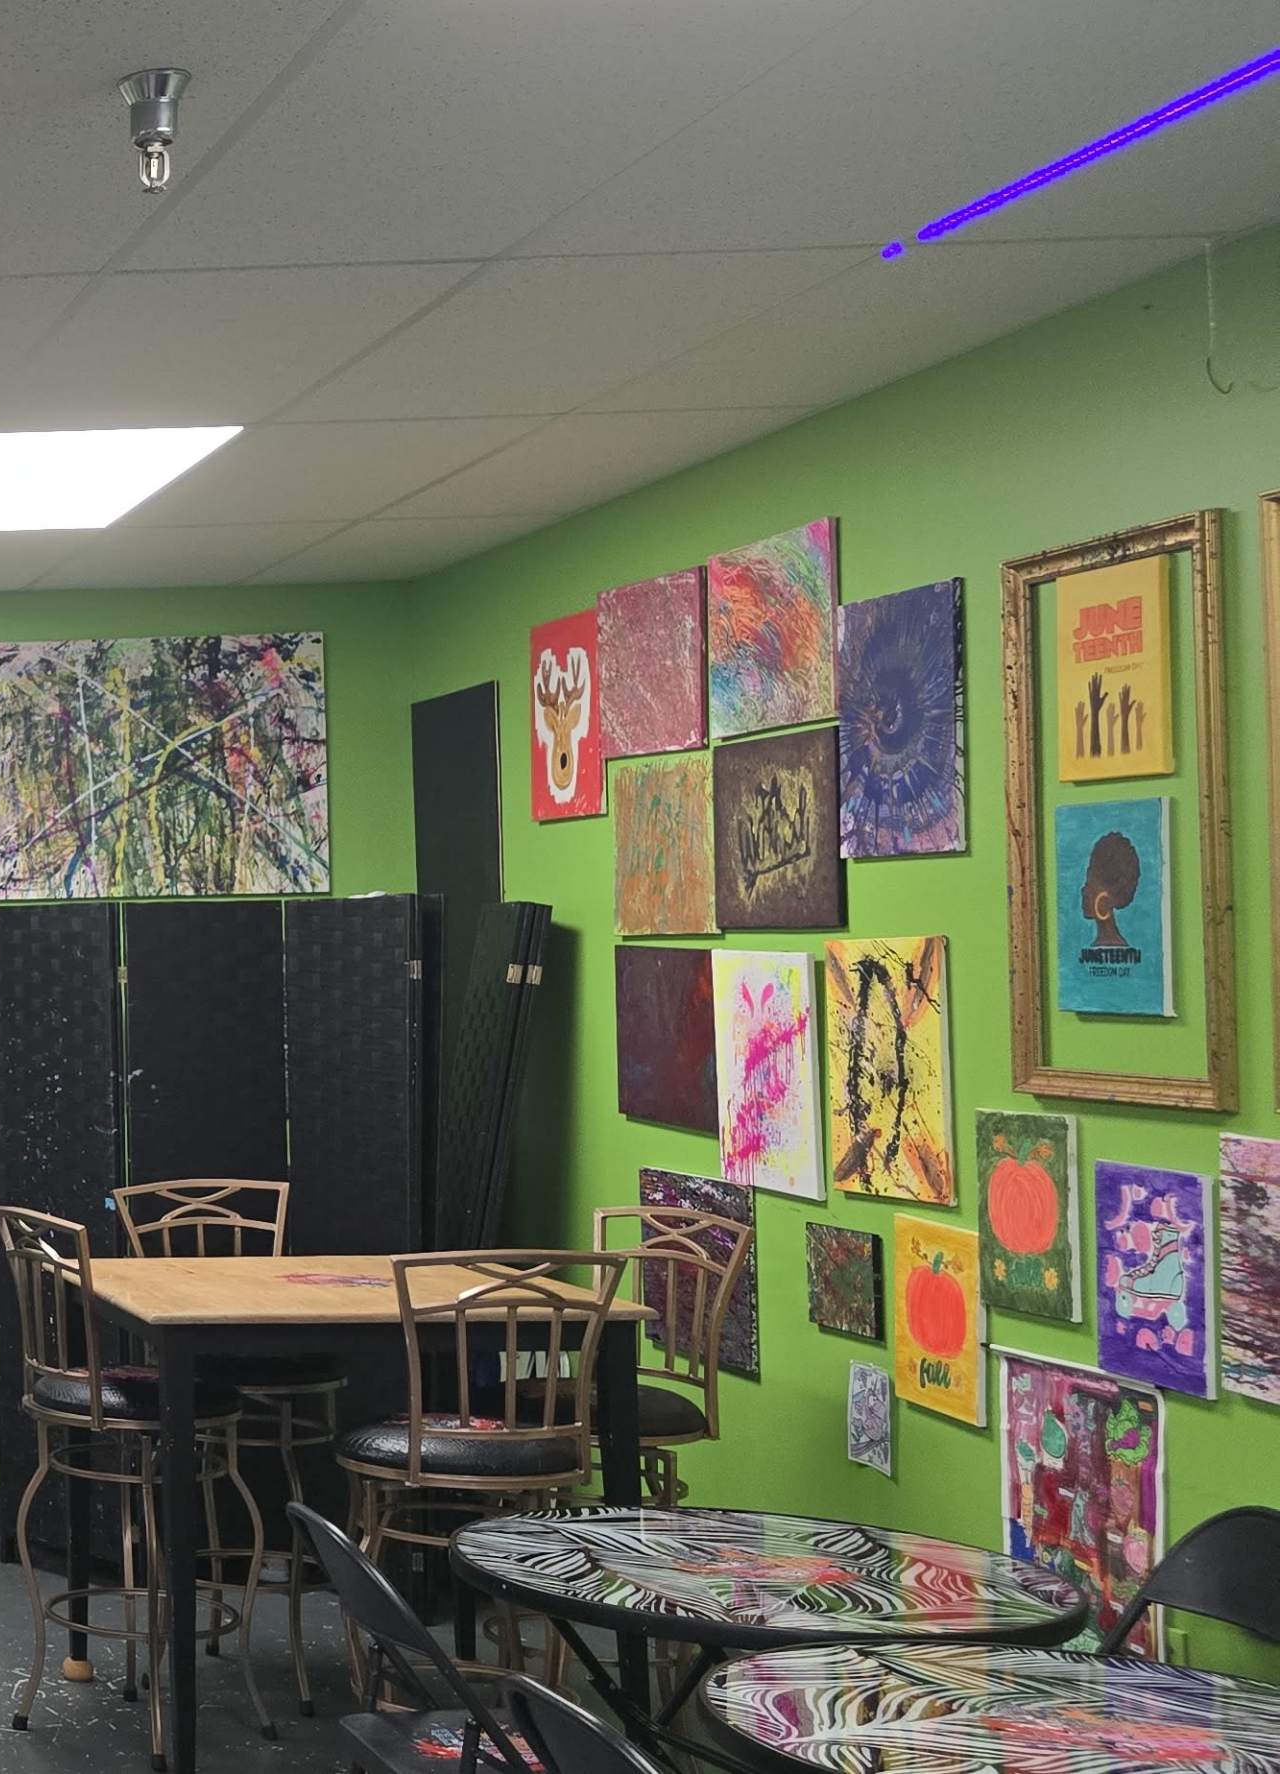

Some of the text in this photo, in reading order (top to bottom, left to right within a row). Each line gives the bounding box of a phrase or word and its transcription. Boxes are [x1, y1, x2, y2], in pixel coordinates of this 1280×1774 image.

[1073, 595, 1143, 641] JUNE
[1072, 630, 1143, 664] TEENTH
[1079, 947, 1142, 964] JUNETEENTH
